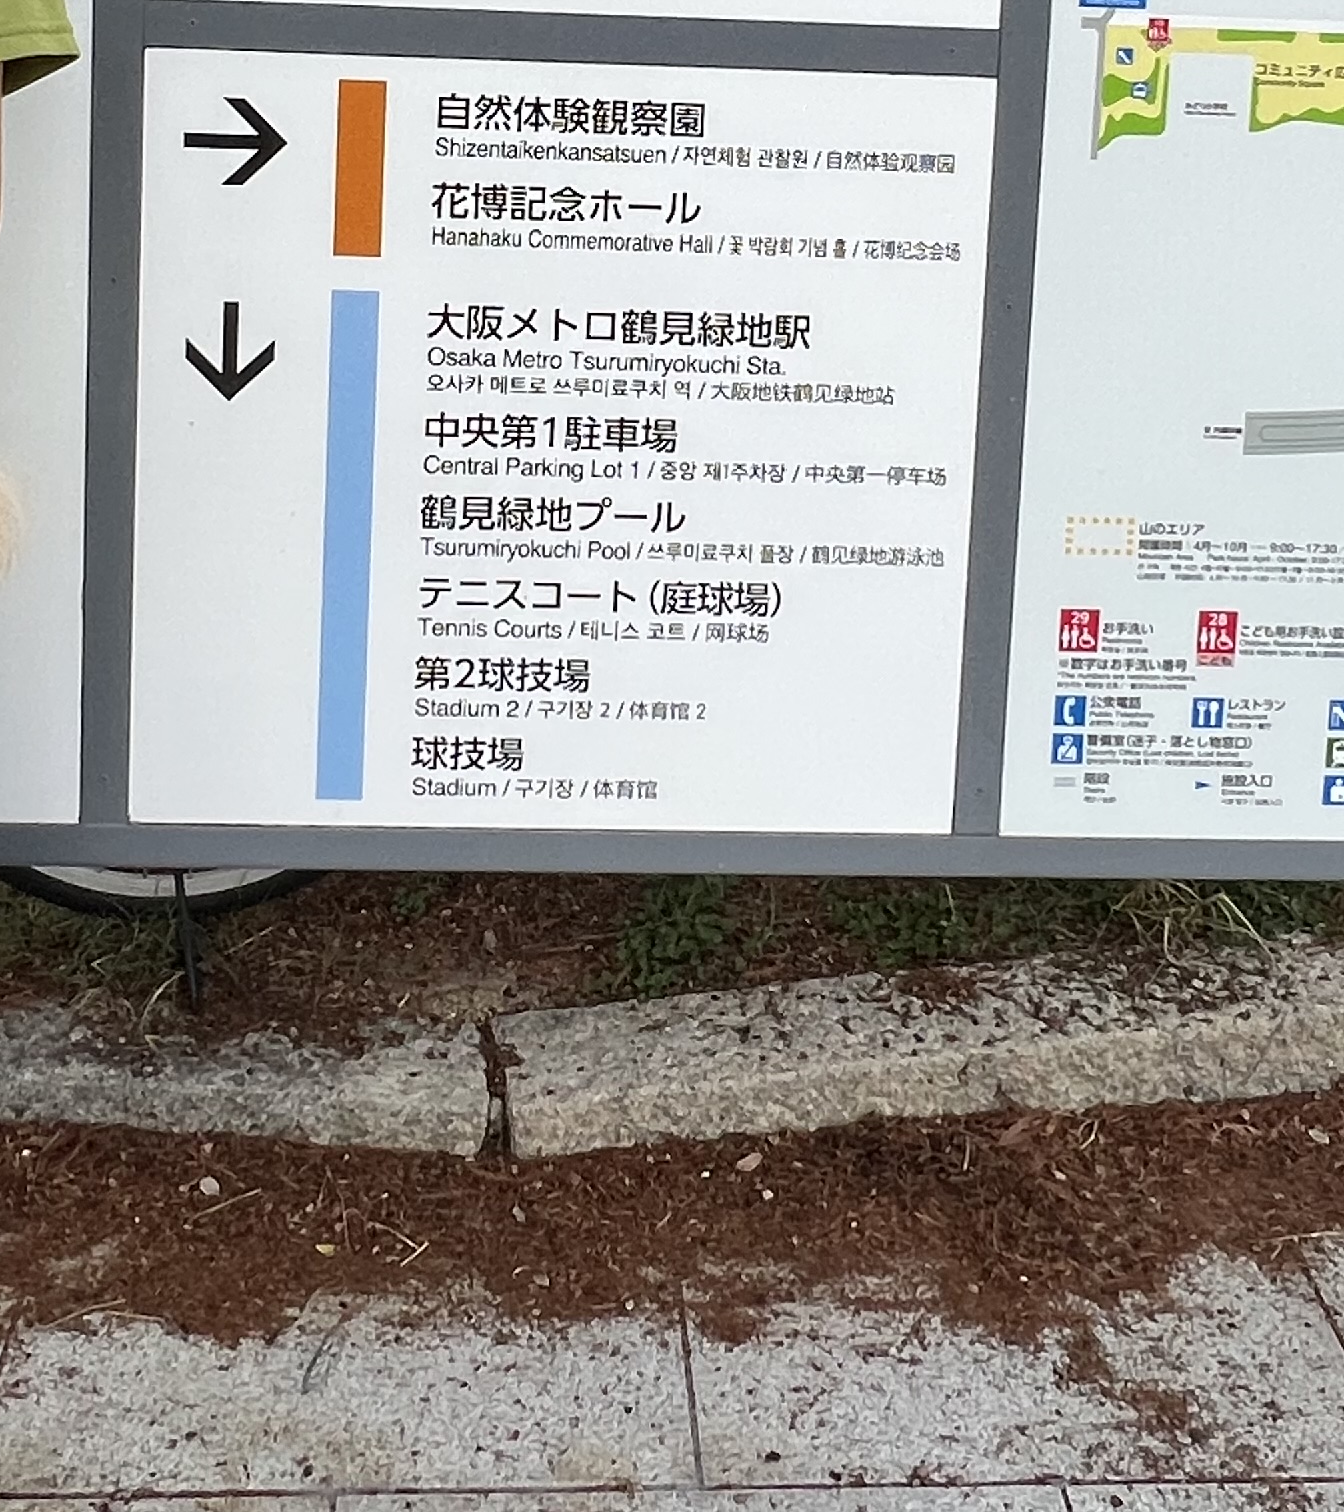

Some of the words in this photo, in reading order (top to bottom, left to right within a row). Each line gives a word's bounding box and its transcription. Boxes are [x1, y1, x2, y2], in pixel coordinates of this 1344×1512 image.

[436, 92, 706, 139] 自然体験観察園
[434, 137, 667, 166] Shizentaikenkansatsuen
[682, 146, 752, 168] 자연체험
[757, 148, 808, 169] 관찰원
[430, 182, 702, 226] 花博記念ホール
[431, 226, 522, 250] Hanahaku
[527, 228, 674, 256] Commemorative
[679, 234, 714, 255] Hall
[748, 236, 793, 257] 박람회
[798, 238, 828, 259] 기념
[863, 239, 961, 262] 花博纪念会场
[427, 303, 811, 350] 大阪メトロ鶴見緑地駅
[427, 347, 497, 370] Osaka
[503, 349, 563, 372] Metro
[570, 351, 741, 381] Tsurumiryokuchi
[746, 355, 787, 377] Sta.
[426, 374, 484, 394] 오사카
[490, 377, 546, 396] 메트로
[552, 378, 668, 399] 쓰루미료쿠치
[674, 381, 693, 401] 역
[424, 412, 678, 454] 中央第1駐車場
[423, 455, 499, 477] Central
[505, 456, 584, 482] Parking
[590, 457, 625, 479] Lot
[630, 459, 639, 479] 1
[660, 459, 698, 482] 중앙
[703, 461, 787, 484] 제1주차장
[420, 495, 686, 534] 鶴見緑地プール
[1138, 522, 1206, 537] 山のエリア
[420, 537, 582, 563] Tsurumiryokuchi
[587, 541, 632, 561] Pool
[647, 543, 753, 564] 쓰루미료쿠치
[419, 577, 636, 613] テニスコート
[649, 579, 781, 618] (庭球場)
[418, 617, 488, 638] Tennis
[493, 620, 562, 640] Courts
[580, 621, 640, 642] 테니스
[646, 623, 686, 641] 코트
[705, 623, 769, 643] 网球场
[1070, 610, 1091, 625] 29
[1207, 612, 1229, 627] 28
[414, 656, 591, 693] 第2球技場
[414, 698, 500, 719] Stadium
[506, 701, 519, 719] 2
[537, 701, 592, 721] 구기장
[629, 702, 689, 722] 体育馆
[696, 703, 706, 721] 2
[1228, 698, 1287, 712] レストラン
[411, 736, 524, 772] 球技場
[411, 778, 497, 797] Stadium
[515, 779, 573, 800] 구기장
[593, 780, 658, 800] 体育馆
